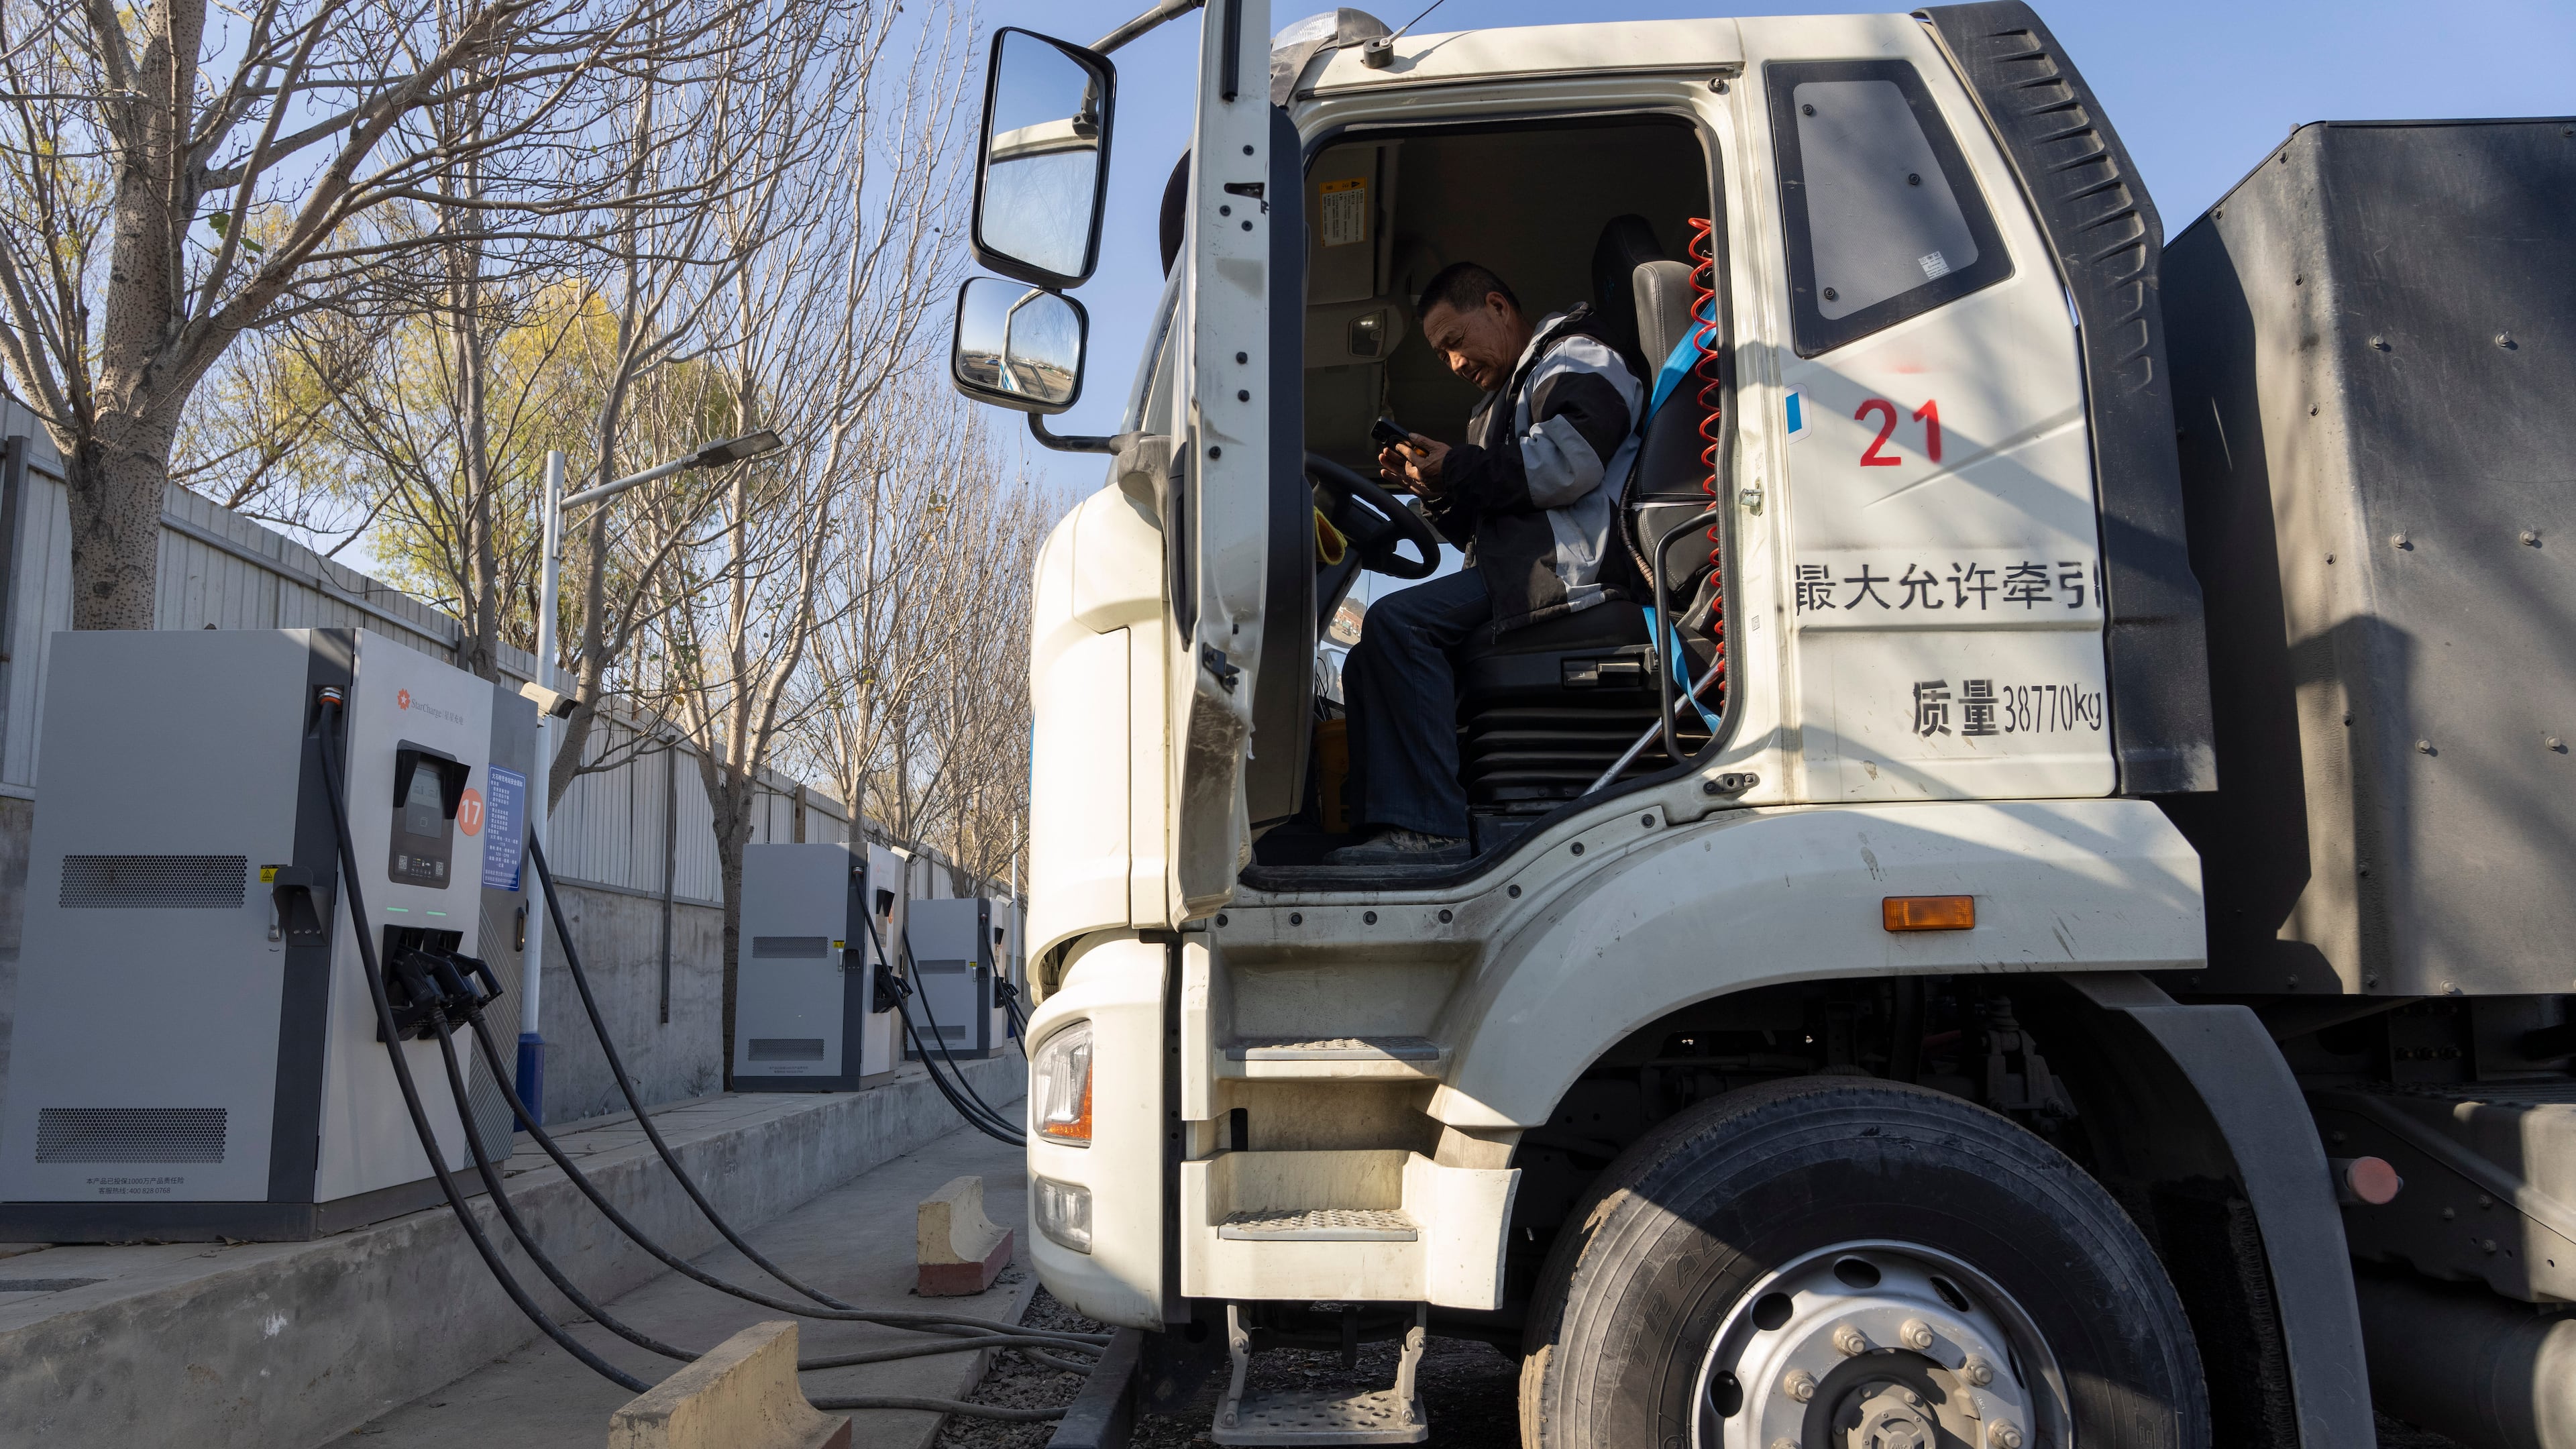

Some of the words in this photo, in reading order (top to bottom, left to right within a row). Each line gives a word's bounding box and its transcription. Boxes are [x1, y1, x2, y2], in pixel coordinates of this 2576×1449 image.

[1854, 398, 1942, 467] 21
[1795, 560, 2101, 616] 最大允许牵引
[411, 698, 442, 718] StarCharge
[462, 799, 481, 825] 17
